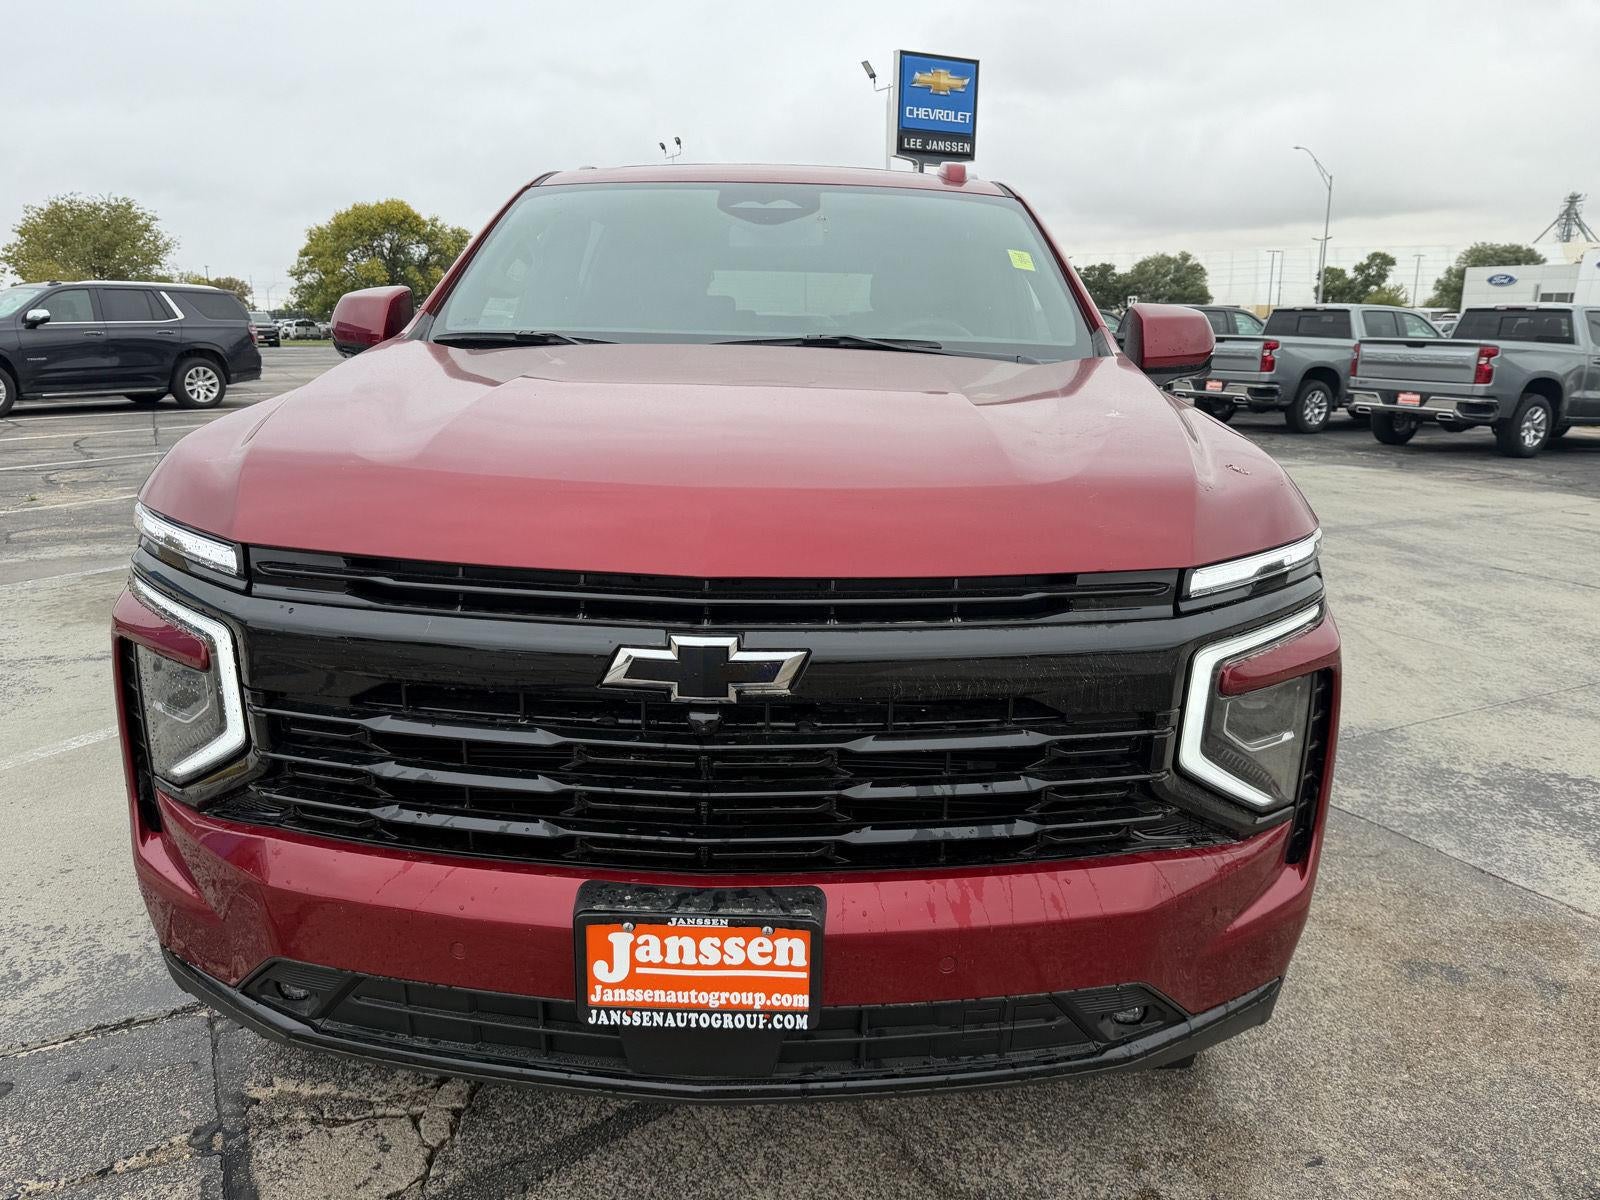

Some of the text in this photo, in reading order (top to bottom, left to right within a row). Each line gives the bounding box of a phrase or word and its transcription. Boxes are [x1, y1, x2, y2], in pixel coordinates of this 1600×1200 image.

[906, 106, 972, 123] CHEVROLET
[904, 138, 970, 152] LEE JANSSEN
[667, 917, 729, 926] JANSSEN
[592, 931, 808, 984] Janssen
[591, 984, 809, 1009] Janssenautogroup.com
